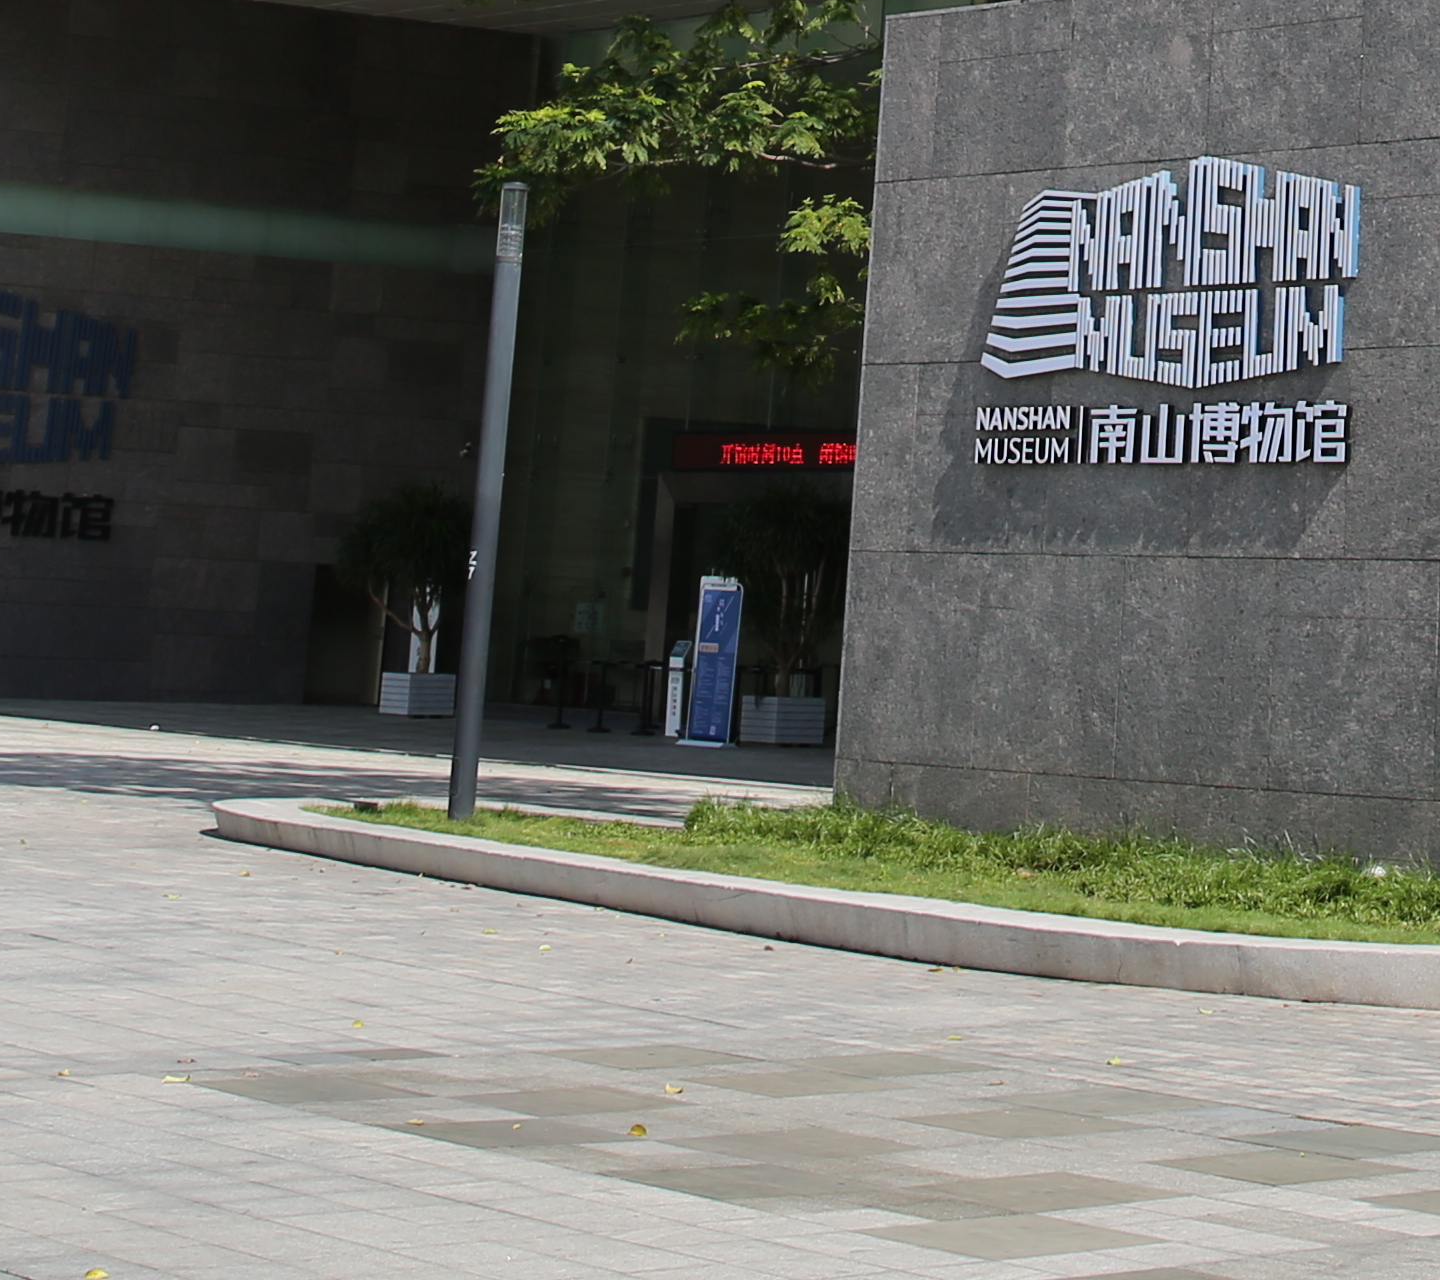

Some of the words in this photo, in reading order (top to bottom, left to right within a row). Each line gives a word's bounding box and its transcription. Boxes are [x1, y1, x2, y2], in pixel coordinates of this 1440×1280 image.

[1068, 156, 1360, 291] NANSHAN
[1075, 284, 1345, 389] MUSEUM
[974, 437, 1069, 465] MUSEUM
[975, 405, 1070, 432] NANSHAN
[1089, 400, 1348, 465] 南山博物馆
